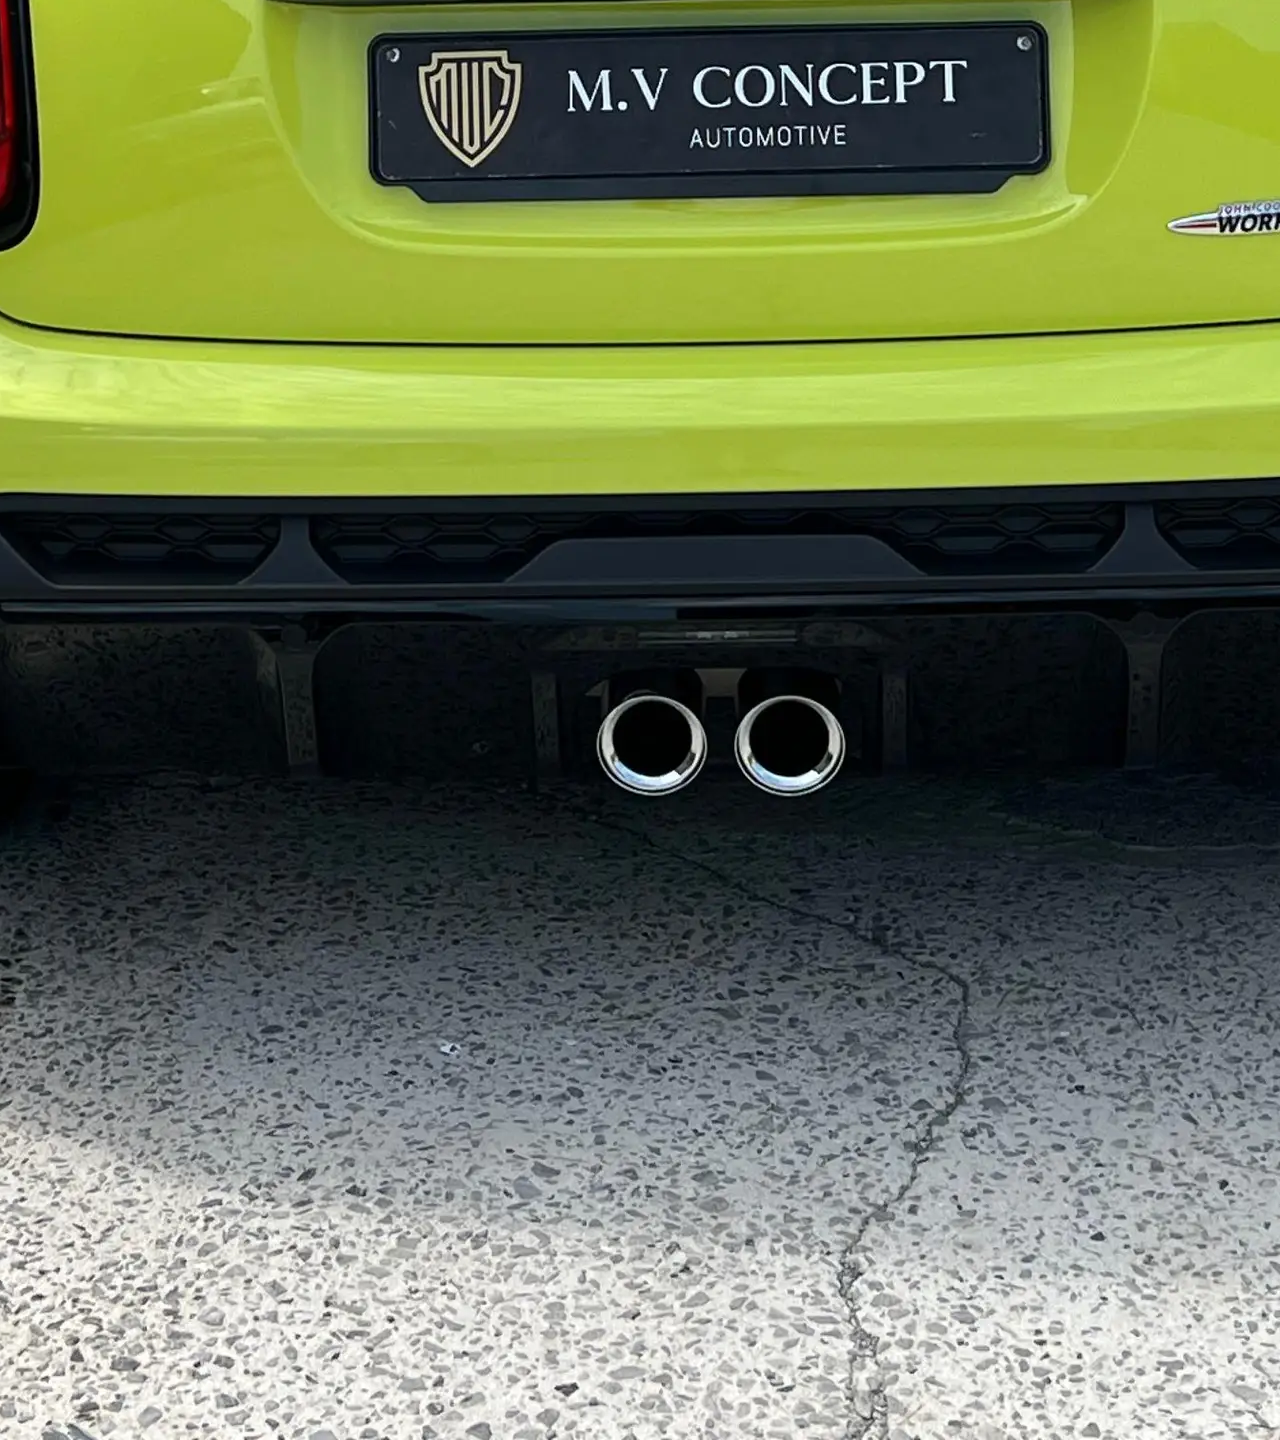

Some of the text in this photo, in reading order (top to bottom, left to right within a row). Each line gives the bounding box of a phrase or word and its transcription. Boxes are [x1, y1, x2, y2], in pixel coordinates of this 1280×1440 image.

[567, 60, 968, 112] M.V CONCEPT
[689, 124, 847, 149] AUTOMOTIVE
[1219, 204, 1251, 215] JOHN
